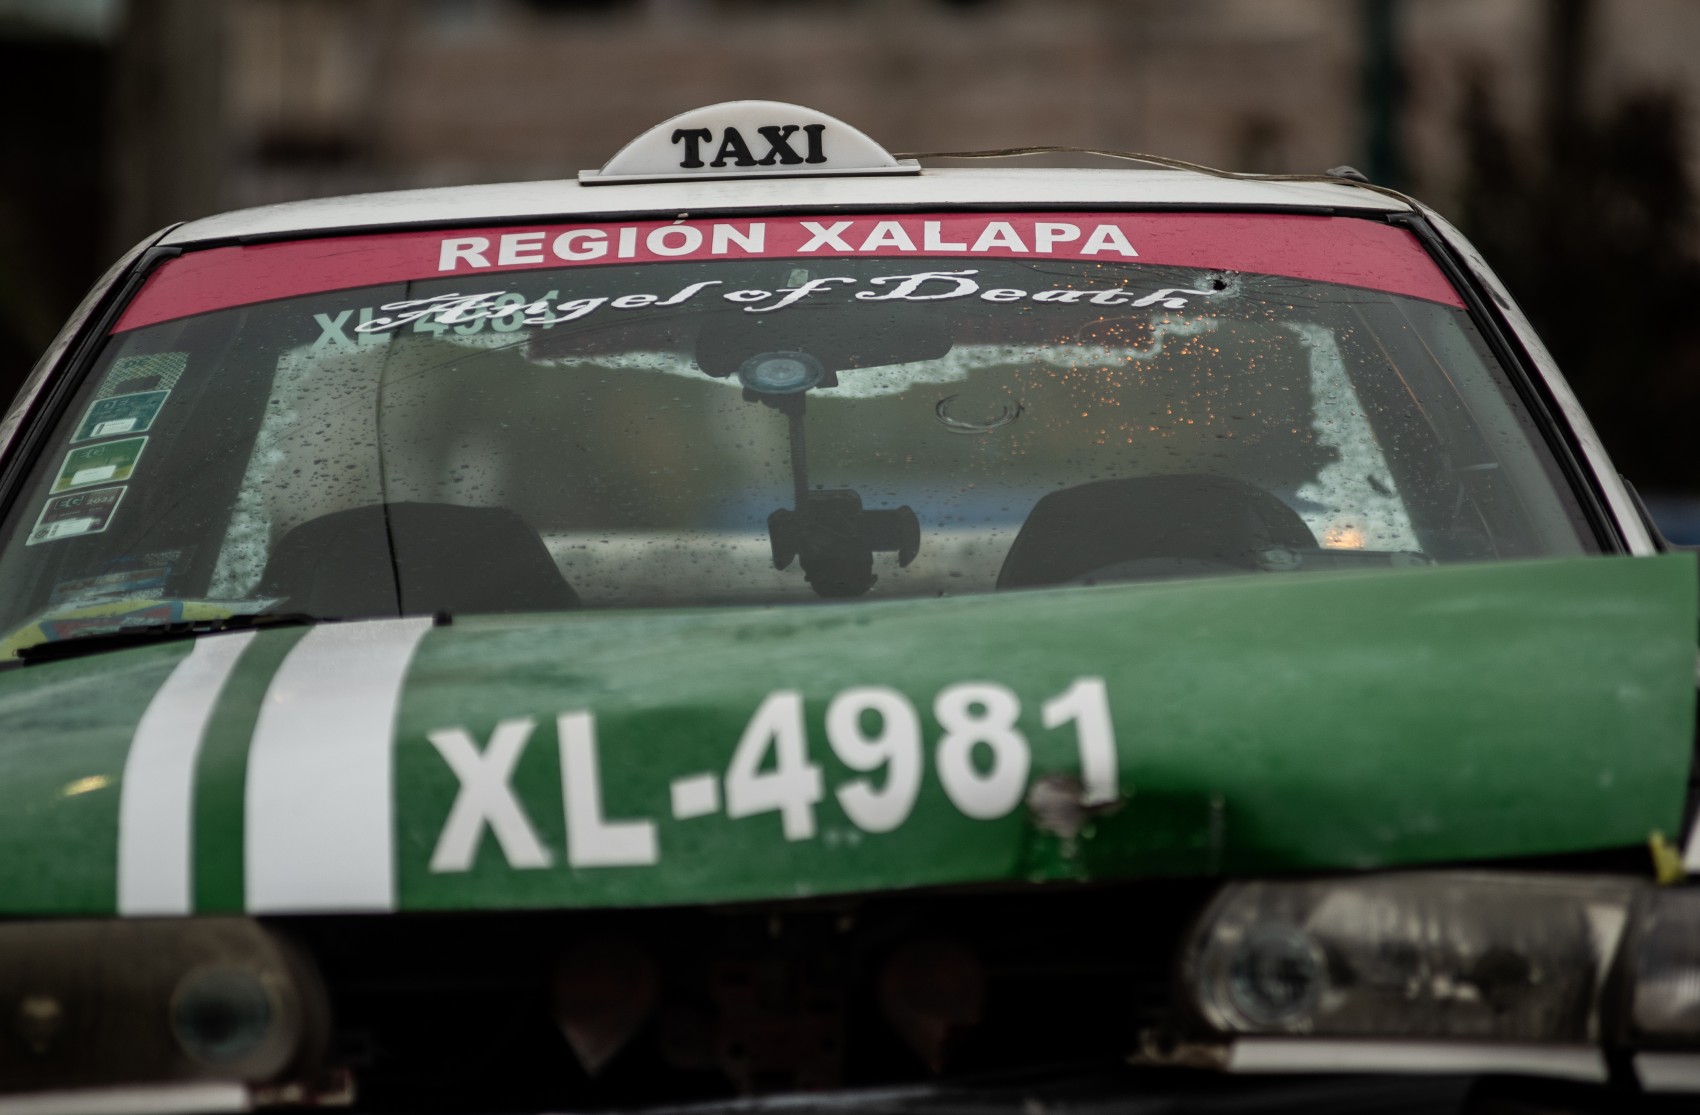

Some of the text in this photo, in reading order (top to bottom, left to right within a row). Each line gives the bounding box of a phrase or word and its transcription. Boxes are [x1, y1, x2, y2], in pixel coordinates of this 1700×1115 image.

[671, 123, 827, 168] TAXI
[438, 212, 1139, 272] REGIÓN XALAPA
[354, 269, 1217, 333] Angel of Death
[426, 677, 1121, 874] XL-4981
